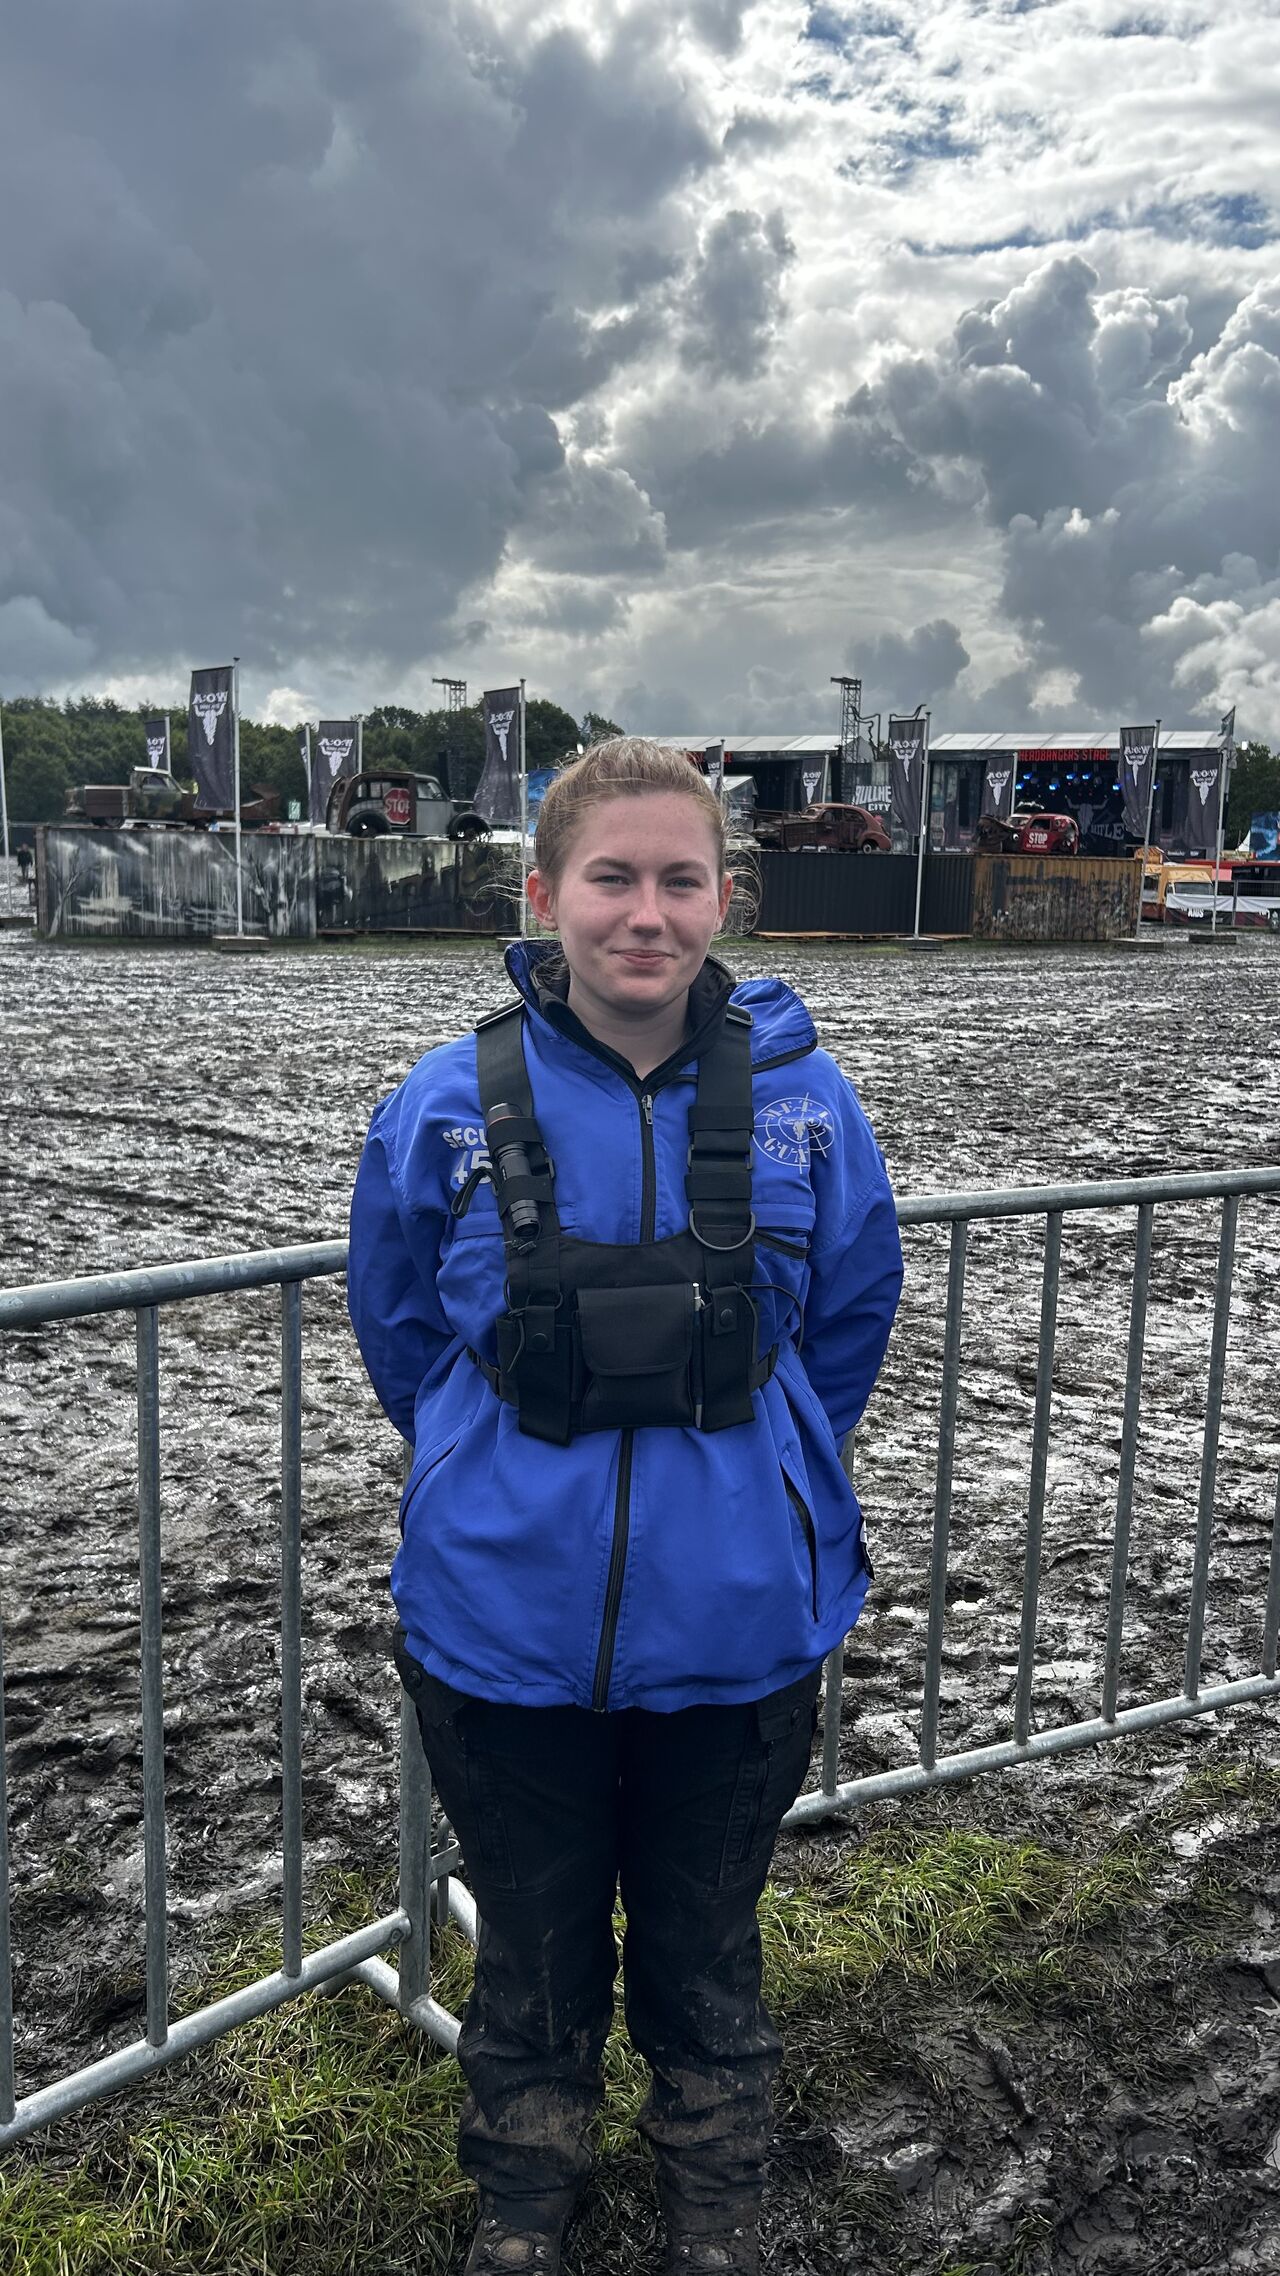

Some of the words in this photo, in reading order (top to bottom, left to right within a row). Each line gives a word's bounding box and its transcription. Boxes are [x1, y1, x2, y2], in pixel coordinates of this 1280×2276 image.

[1019, 750, 1080, 761] HEADBANGERS
[1082, 749, 1110, 761] STAGE
[868, 803, 890, 811] CITY
[1028, 832, 1048, 844] STOP
